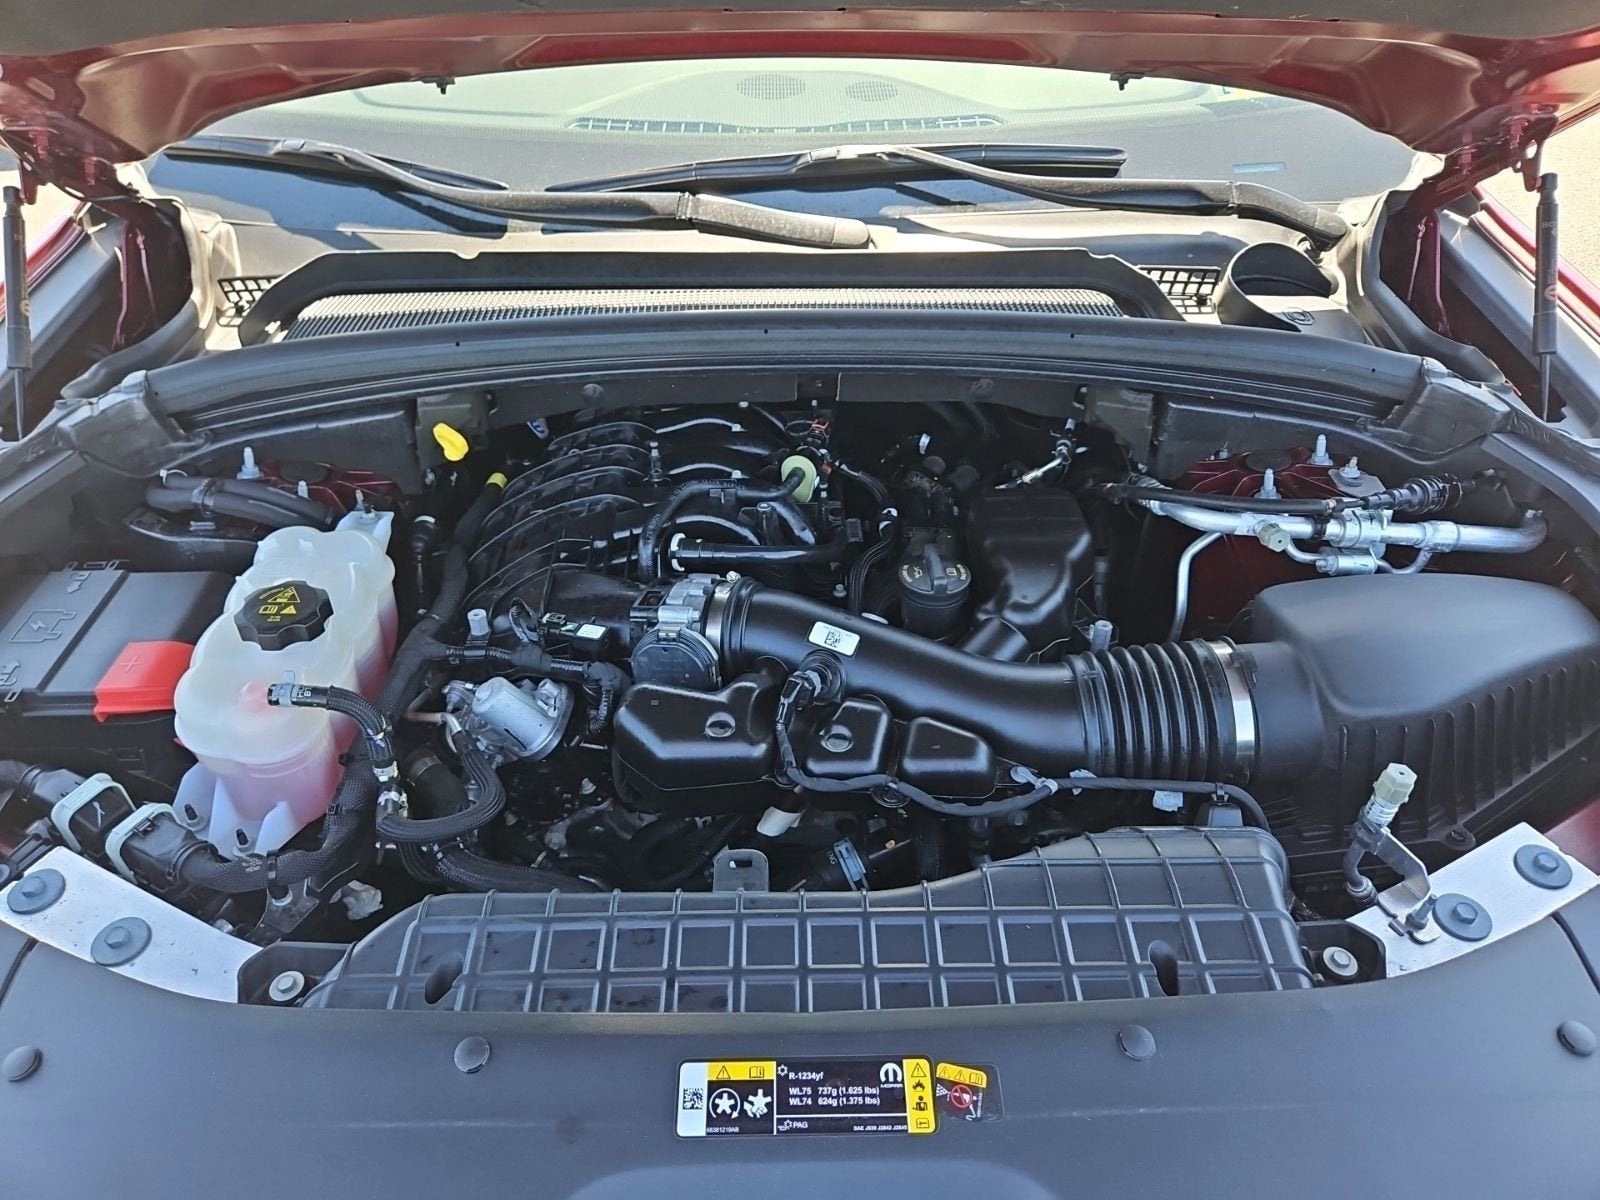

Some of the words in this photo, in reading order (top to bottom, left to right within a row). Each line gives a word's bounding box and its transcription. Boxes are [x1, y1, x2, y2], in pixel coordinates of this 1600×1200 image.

[788, 1071, 824, 1081] R-1234yf
[789, 1087, 812, 1095] WL75
[818, 1087, 838, 1096] 737g
[839, 1086, 863, 1096] (1.625
[864, 1086, 880, 1095] lbs)
[789, 1097, 812, 1106] WL74
[818, 1097, 838, 1106] 624g
[839, 1097, 863, 1106] (1.375
[864, 1096, 880, 1106] lbs)
[792, 1121, 808, 1129] PAG
